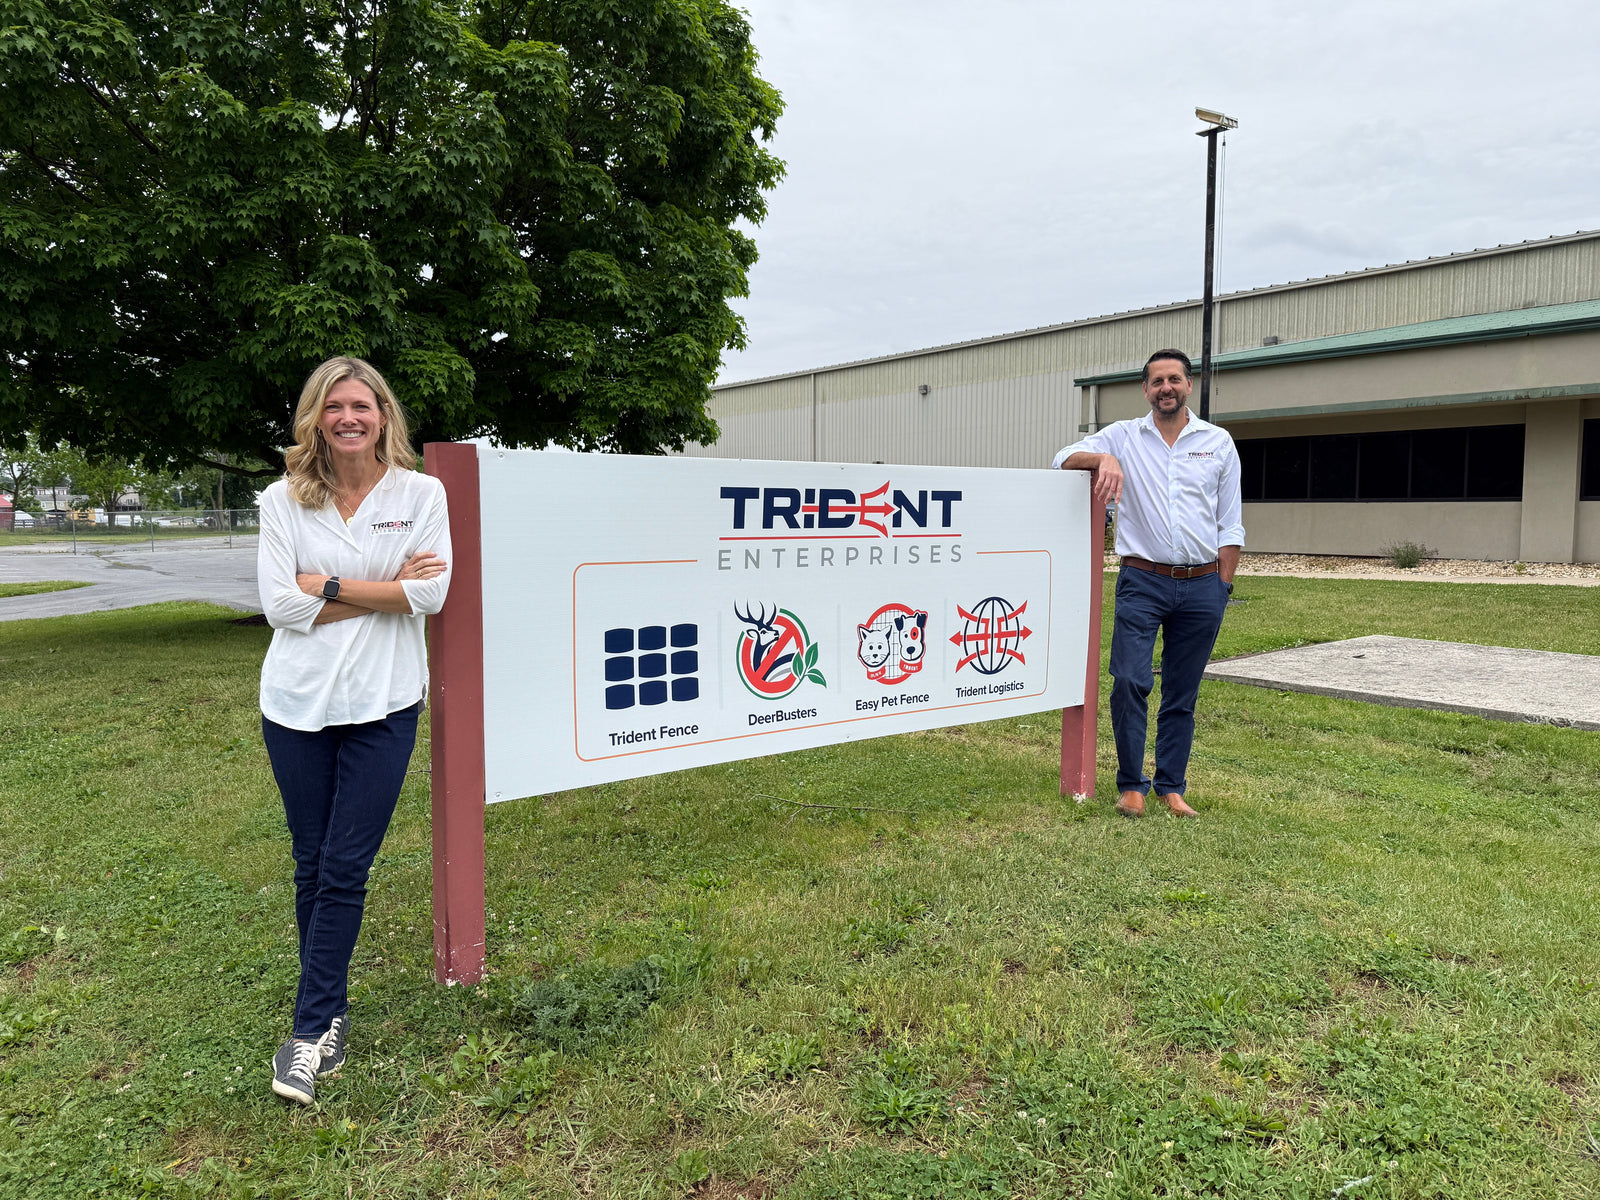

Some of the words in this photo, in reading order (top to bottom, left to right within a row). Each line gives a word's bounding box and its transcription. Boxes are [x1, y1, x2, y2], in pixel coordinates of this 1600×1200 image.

[720, 480, 962, 538] TRIDENT
[371, 520, 413, 530] TRIDENT
[718, 545, 962, 570] ENTERPRISES
[956, 686, 987, 698] Trident
[988, 680, 1024, 695] Logistics
[855, 699, 879, 711] Easy
[881, 696, 898, 707] Pet
[900, 693, 930, 705] Fence
[748, 708, 817, 726] DeerBusters
[609, 730, 657, 746] Trident
[660, 724, 699, 739] Fence
